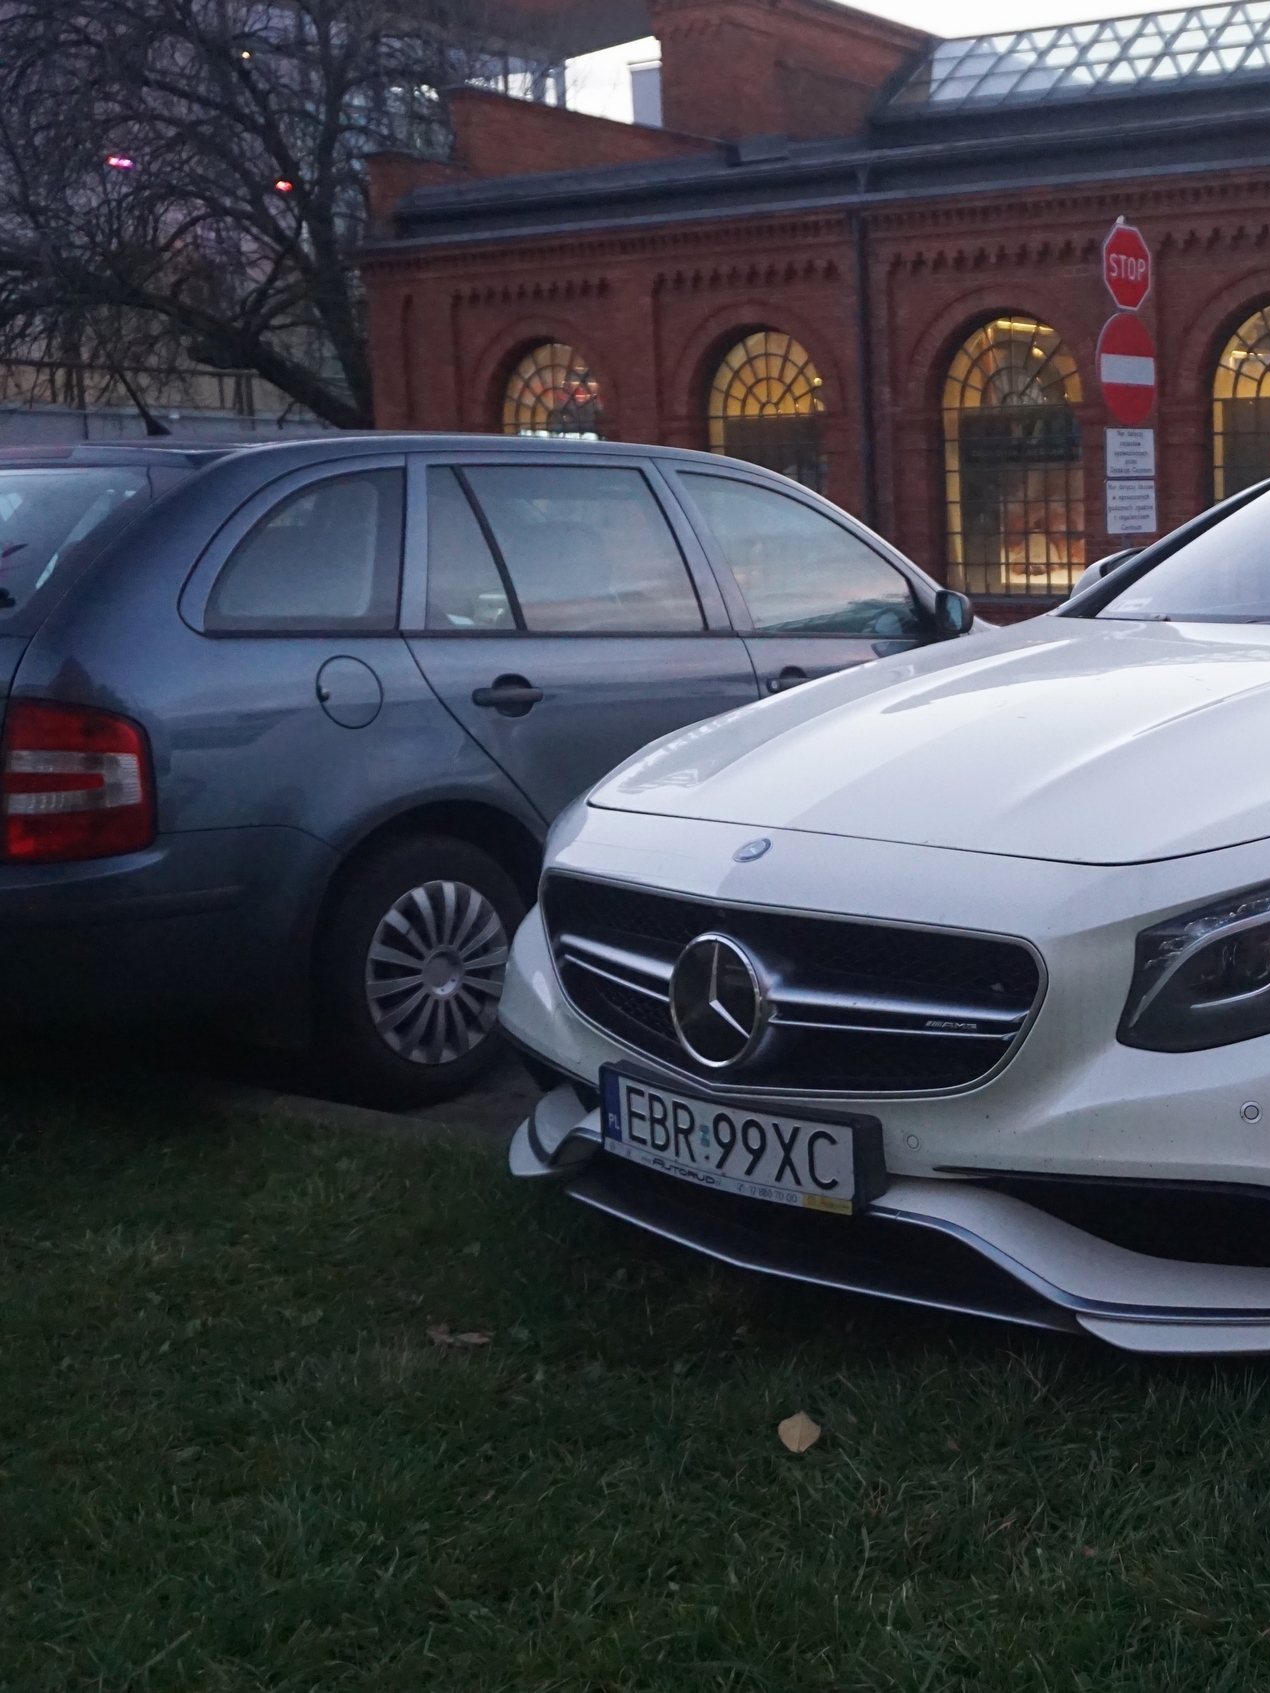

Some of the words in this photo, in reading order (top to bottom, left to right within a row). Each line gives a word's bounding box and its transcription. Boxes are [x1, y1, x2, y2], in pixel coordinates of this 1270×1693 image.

[1109, 252, 1146, 281] STOP
[608, 1112, 620, 1130] PL
[625, 1085, 697, 1163] EBR
[712, 1111, 839, 1190] 99XC
